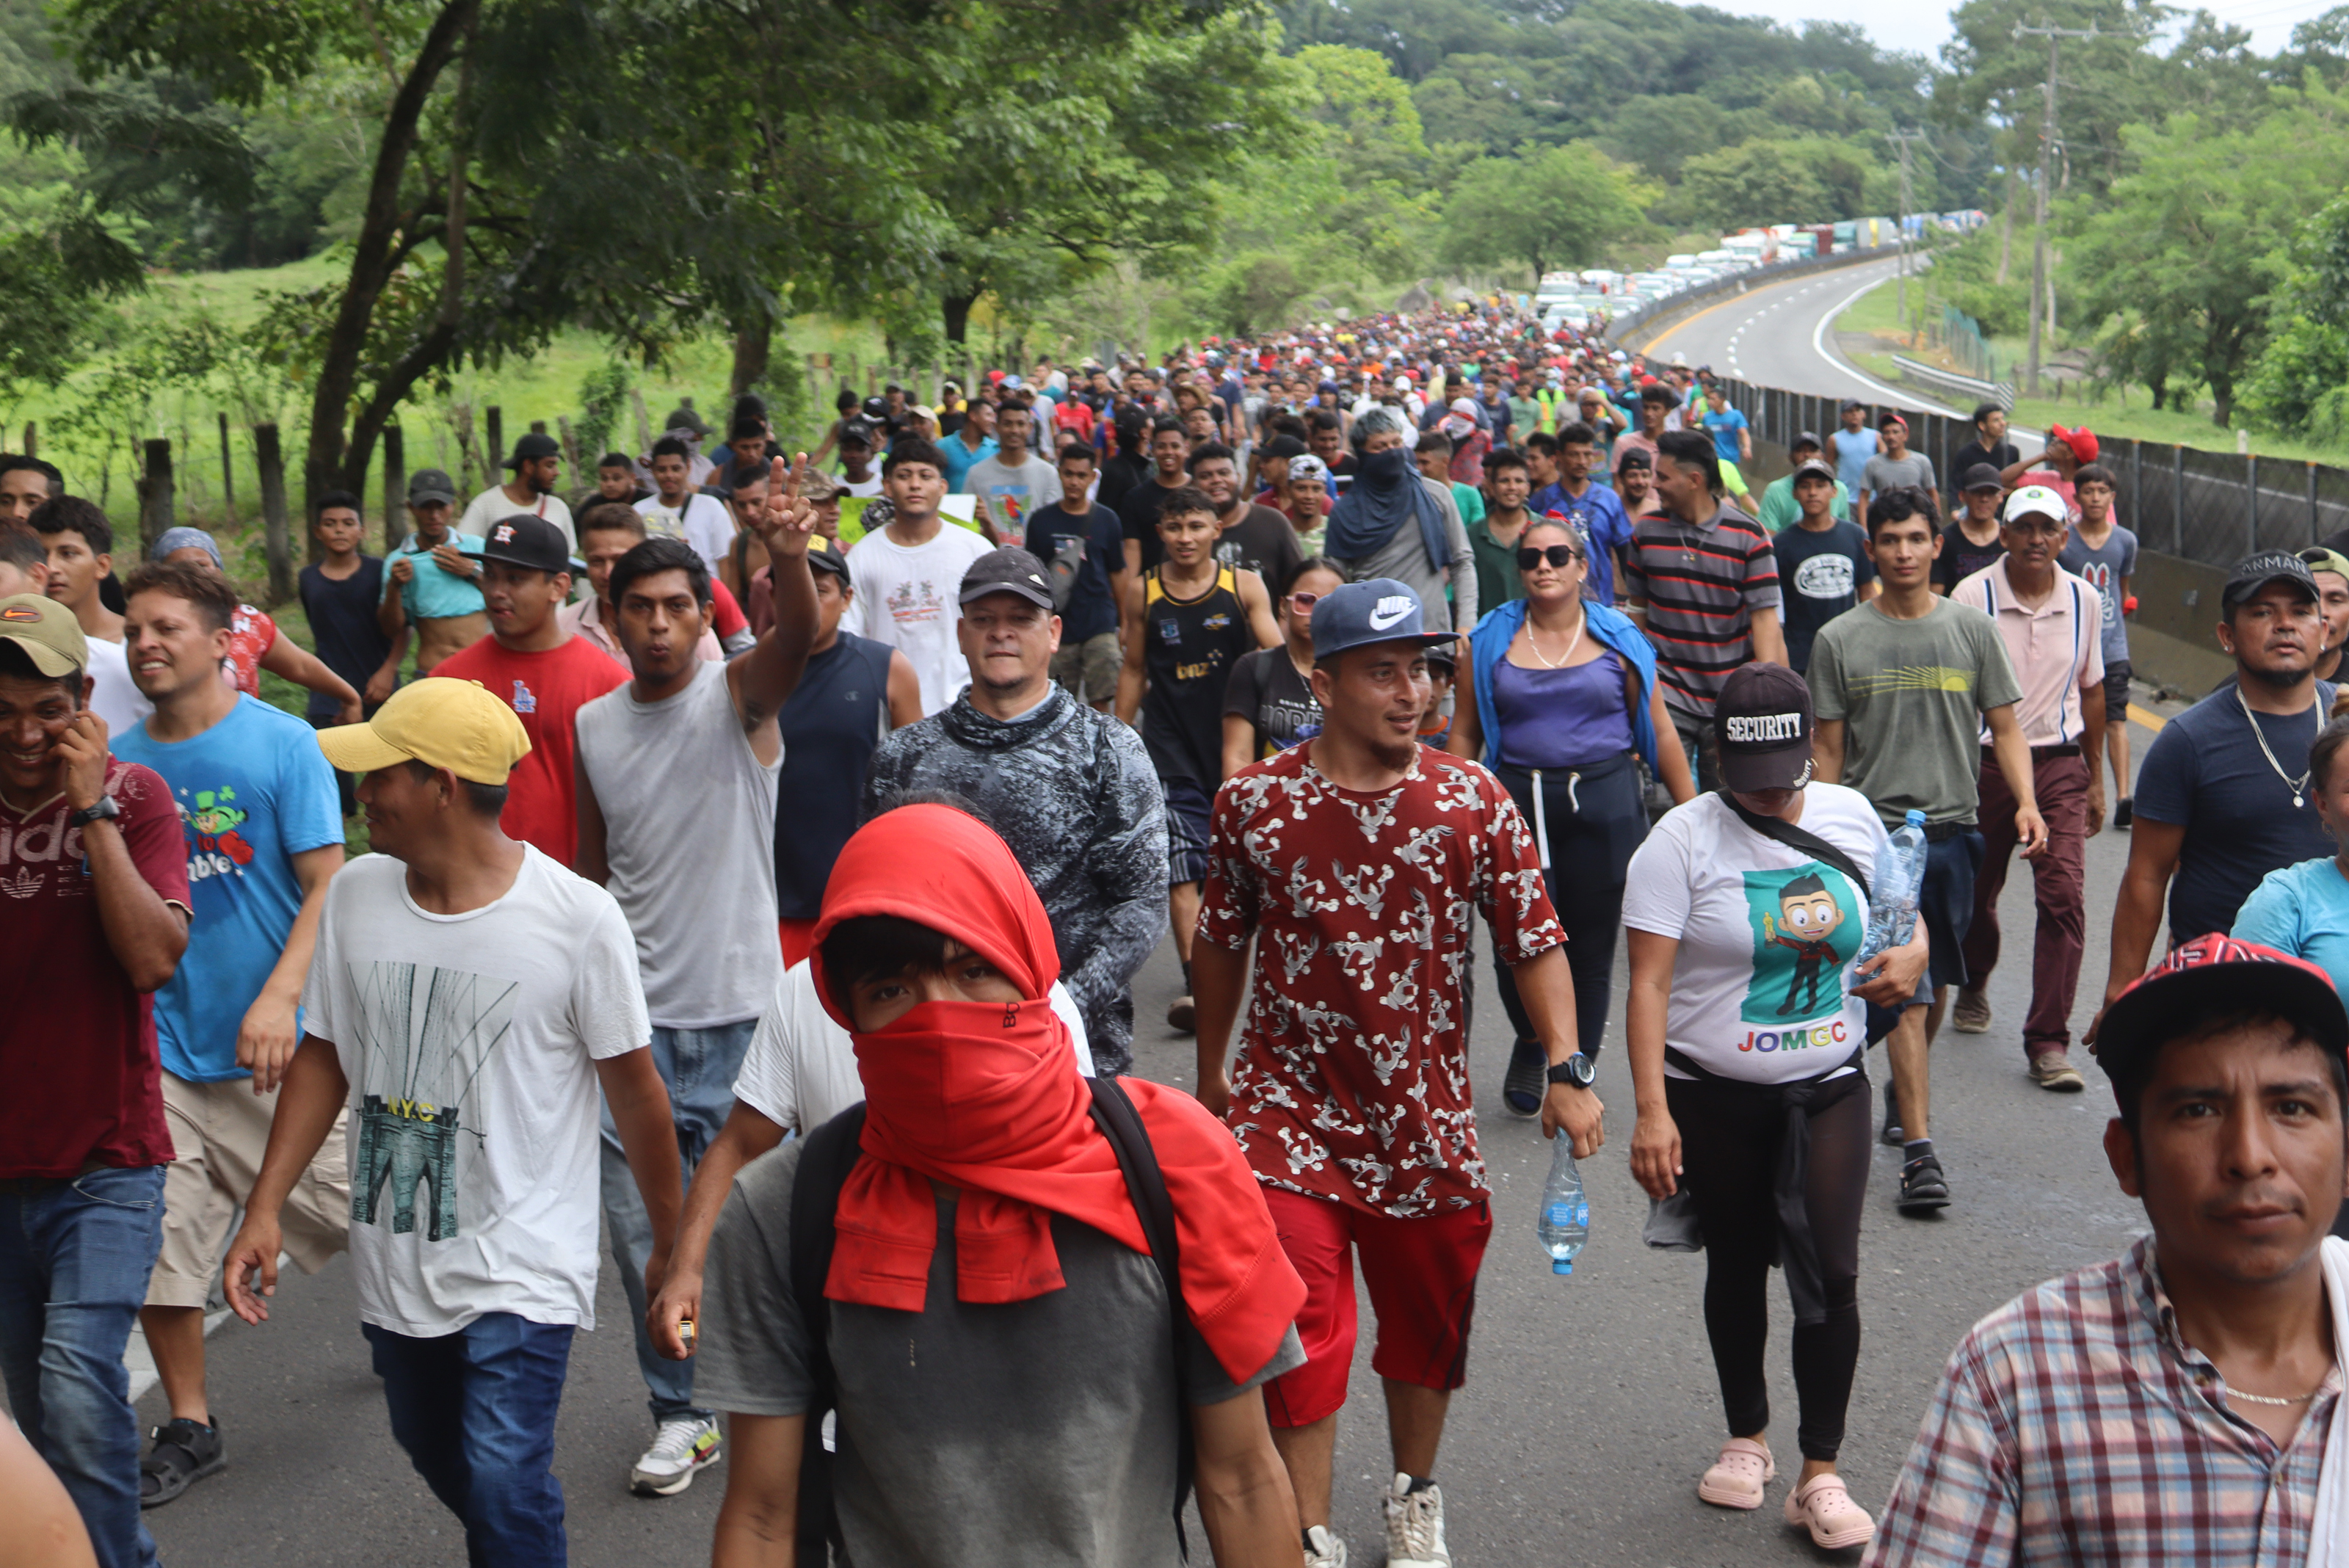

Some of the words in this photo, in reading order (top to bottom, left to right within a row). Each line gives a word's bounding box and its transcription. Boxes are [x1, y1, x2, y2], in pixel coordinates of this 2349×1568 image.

[1376, 595, 1413, 615] NIKE
[1176, 662, 1210, 680] bnz
[1727, 712, 1801, 741] SECURITY
[197, 834, 215, 851] to
[1738, 1021, 1847, 1052] JOMGC
